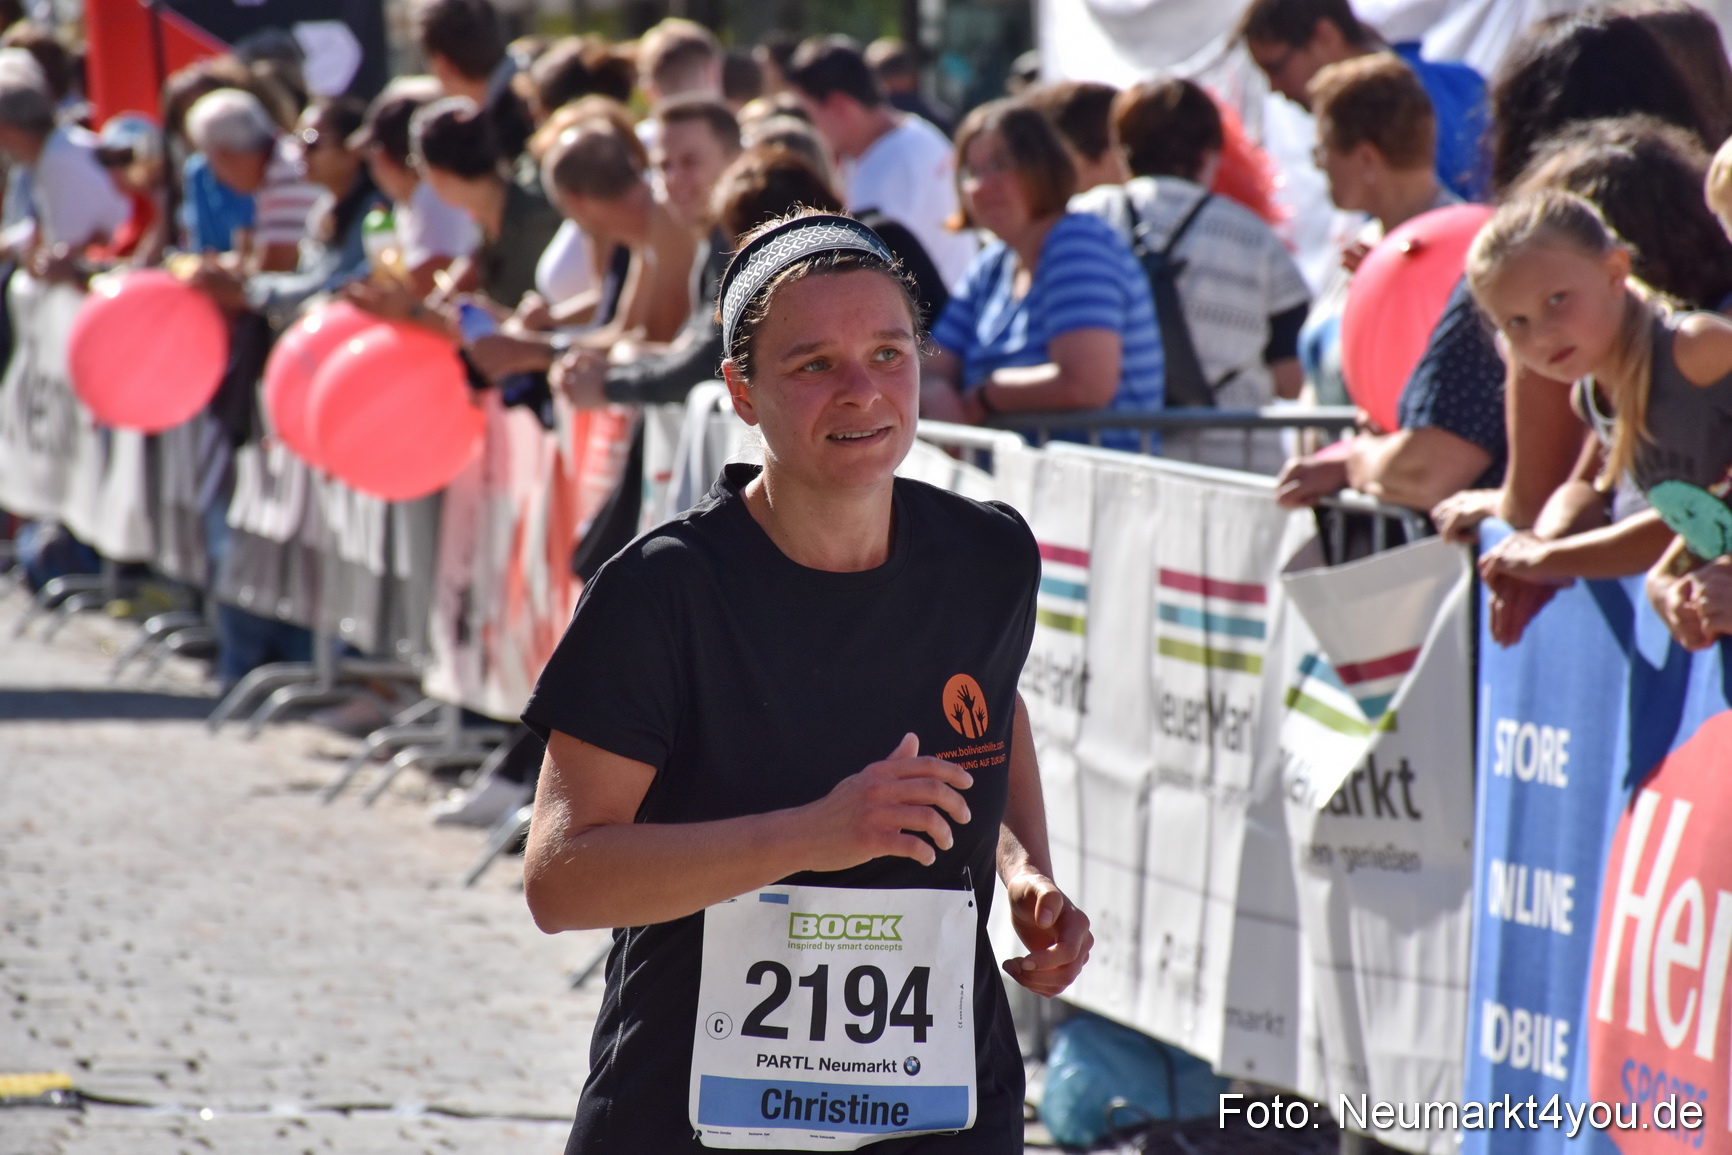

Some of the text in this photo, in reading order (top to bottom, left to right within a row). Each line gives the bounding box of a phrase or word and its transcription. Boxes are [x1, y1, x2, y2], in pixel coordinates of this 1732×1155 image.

[1494, 717, 1571, 788] STORE
[1320, 753, 1421, 821] arkt
[787, 940, 903, 952] inspired by smart concepts
[789, 912, 904, 941] BOCK
[1596, 787, 1732, 1072] Her
[741, 960, 933, 1044] 2194
[714, 1018, 725, 1033] C
[756, 1053, 814, 1070] PARTL
[819, 1057, 897, 1073] Neumarkt
[761, 1087, 910, 1126] Christine
